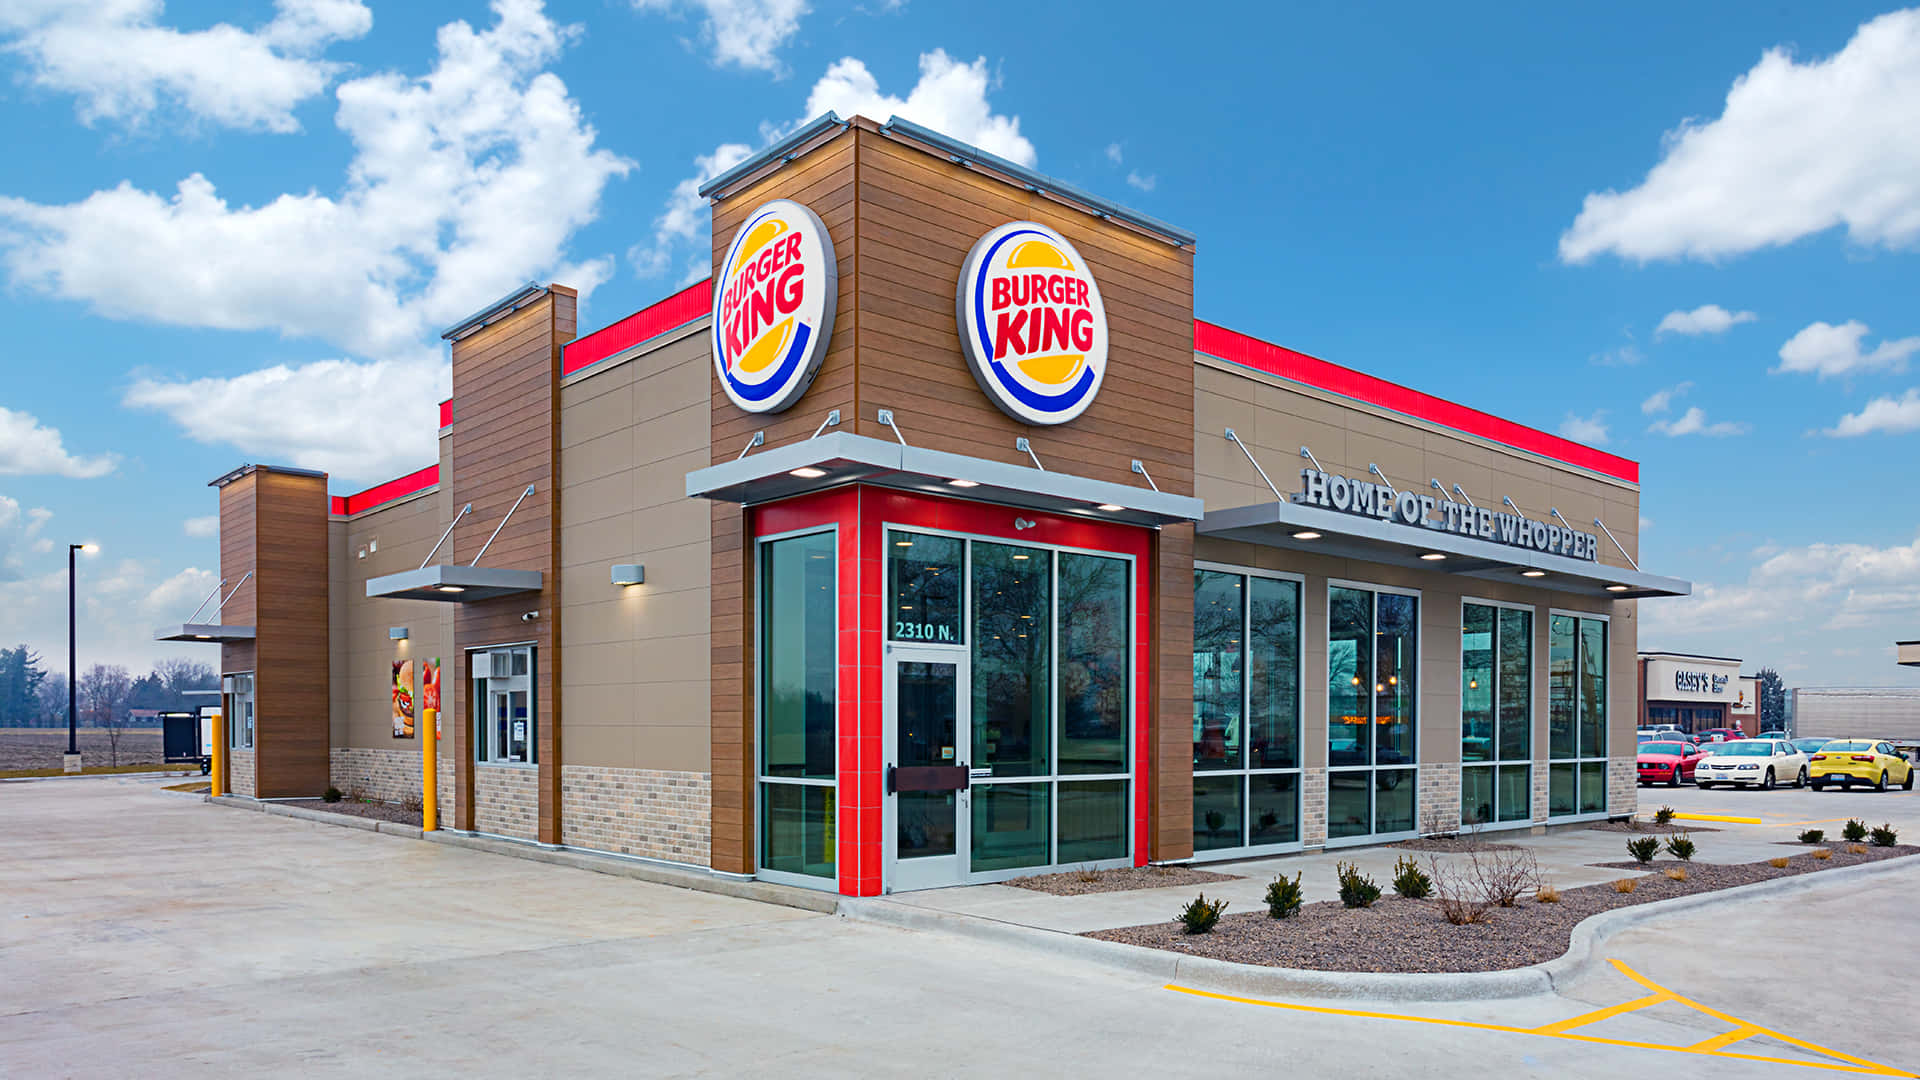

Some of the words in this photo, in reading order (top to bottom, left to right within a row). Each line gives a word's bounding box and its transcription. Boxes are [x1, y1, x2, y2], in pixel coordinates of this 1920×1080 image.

[724, 231, 802, 319] BURGER
[992, 274, 1091, 311] BURGER
[725, 263, 805, 372] KING
[994, 307, 1094, 360] KING
[1301, 468, 1393, 518] HOME
[1396, 491, 1436, 526] OF
[1439, 500, 1493, 538] THE
[1494, 512, 1598, 560] WHOPPER
[895, 622, 934, 640] 2310
[938, 624, 955, 641] N.
[1676, 670, 1709, 693] CASEY'S
